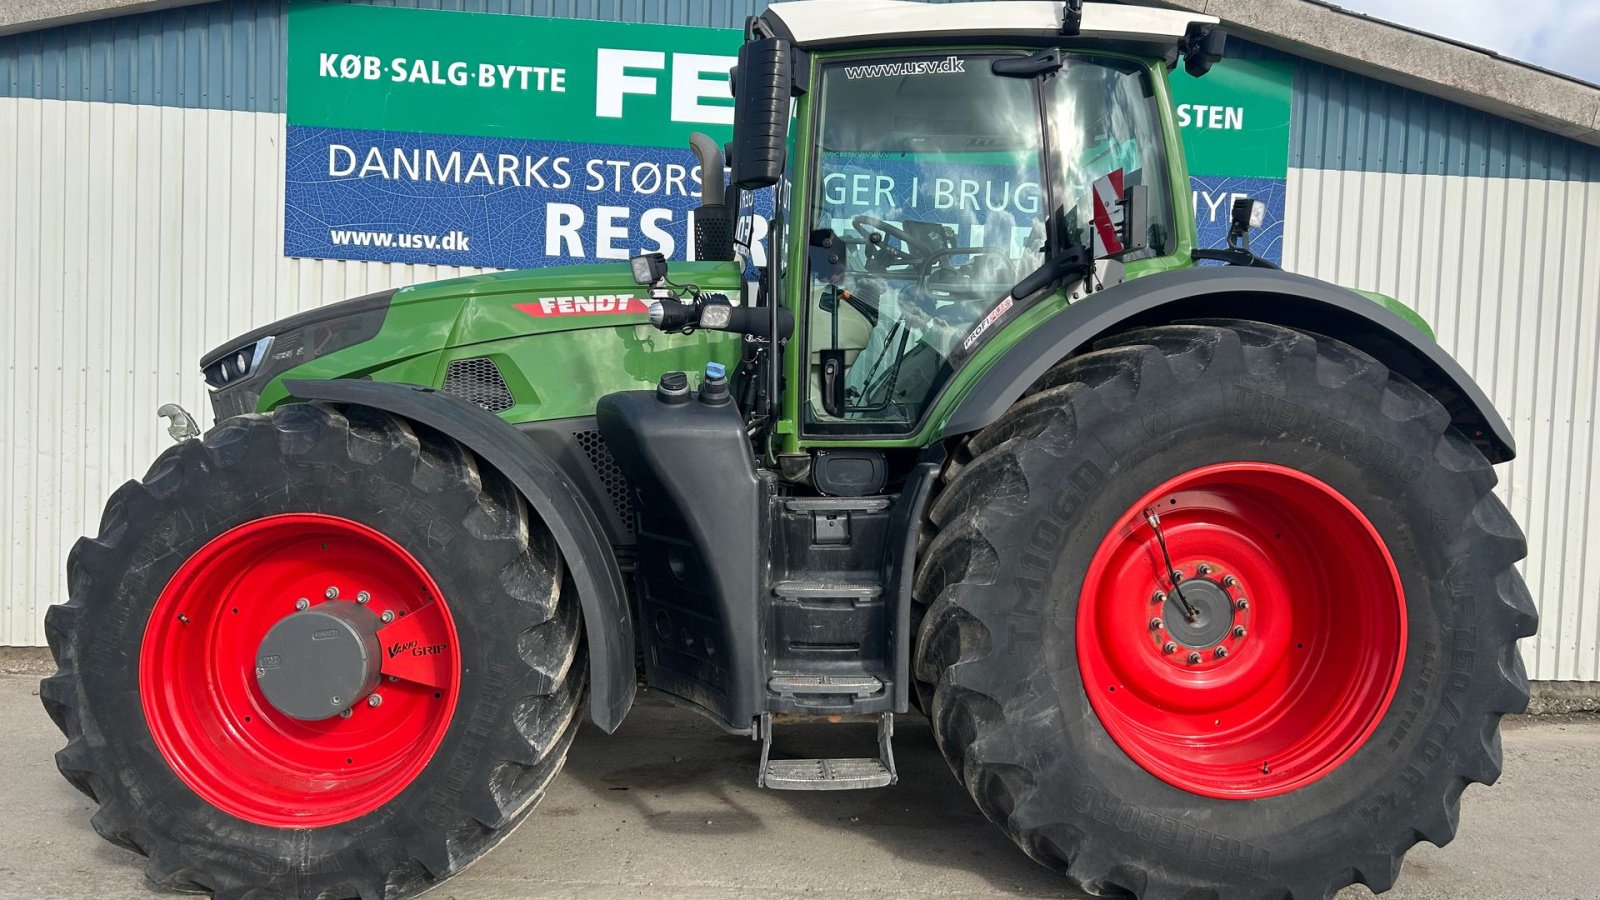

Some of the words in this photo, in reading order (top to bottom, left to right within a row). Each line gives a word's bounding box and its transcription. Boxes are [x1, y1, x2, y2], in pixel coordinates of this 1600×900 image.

[845, 56, 965, 79] www.usv.dk
[1176, 104, 1244, 131] STEN
[329, 144, 571, 189] DANMARKS
[329, 229, 470, 252] www.usv.dk
[538, 293, 634, 315] FENDT
[412, 644, 448, 657] GRIP
